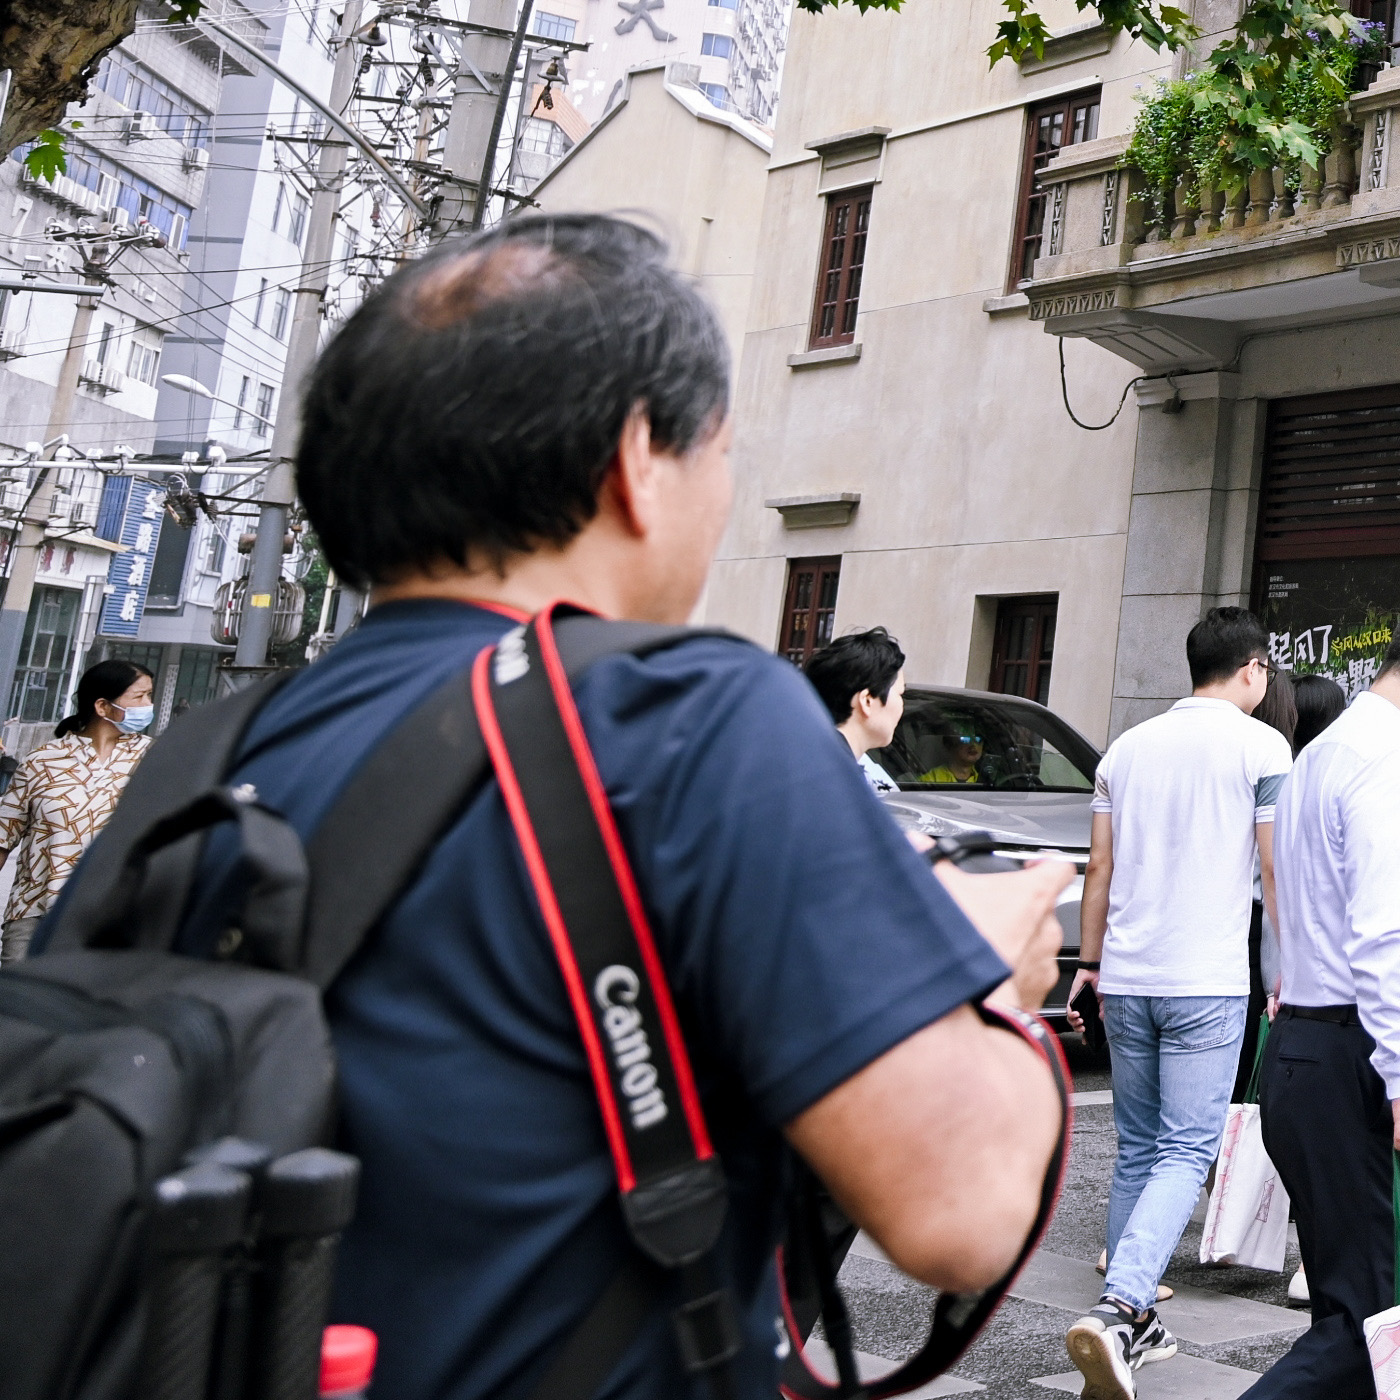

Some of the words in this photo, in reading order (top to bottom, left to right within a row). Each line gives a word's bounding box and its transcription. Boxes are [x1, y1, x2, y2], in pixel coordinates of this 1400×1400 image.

[1267, 624, 1333, 670] 起风了
[595, 964, 668, 1130] Canon
